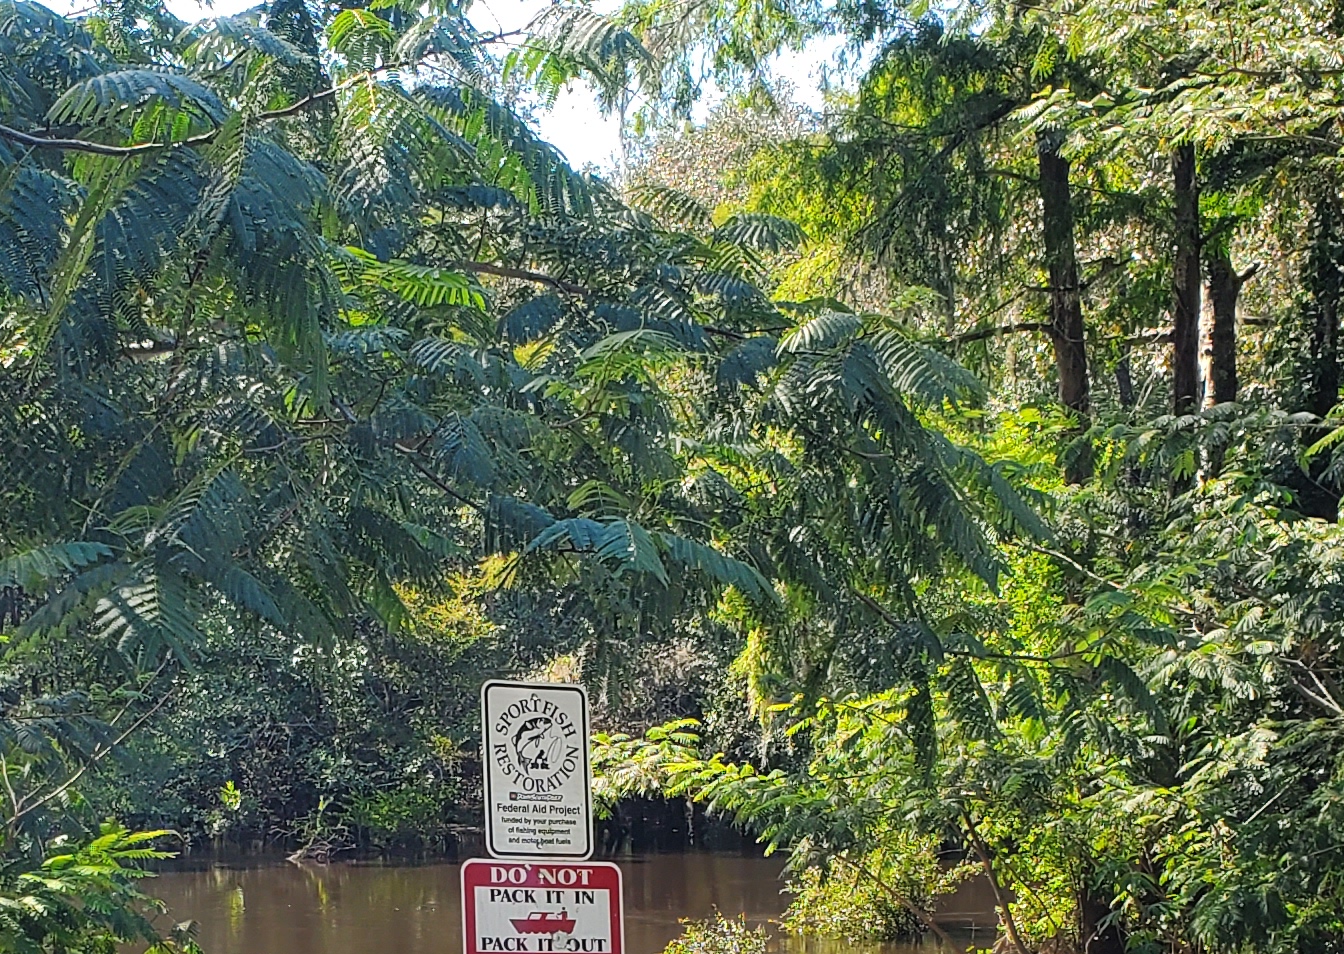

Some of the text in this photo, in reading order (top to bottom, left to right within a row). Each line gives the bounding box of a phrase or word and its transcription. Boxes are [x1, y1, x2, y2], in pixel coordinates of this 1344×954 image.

[542, 701, 577, 738] FISH
[494, 743, 579, 792] RESTORATION
[497, 803, 581, 816] Federal Aid Project
[524, 817, 531, 825] by
[516, 827, 536, 835] fishing
[490, 867, 593, 885] DO NOT
[490, 889, 594, 904] PACK IT IN
[481, 937, 606, 952] PACK IT OUT
